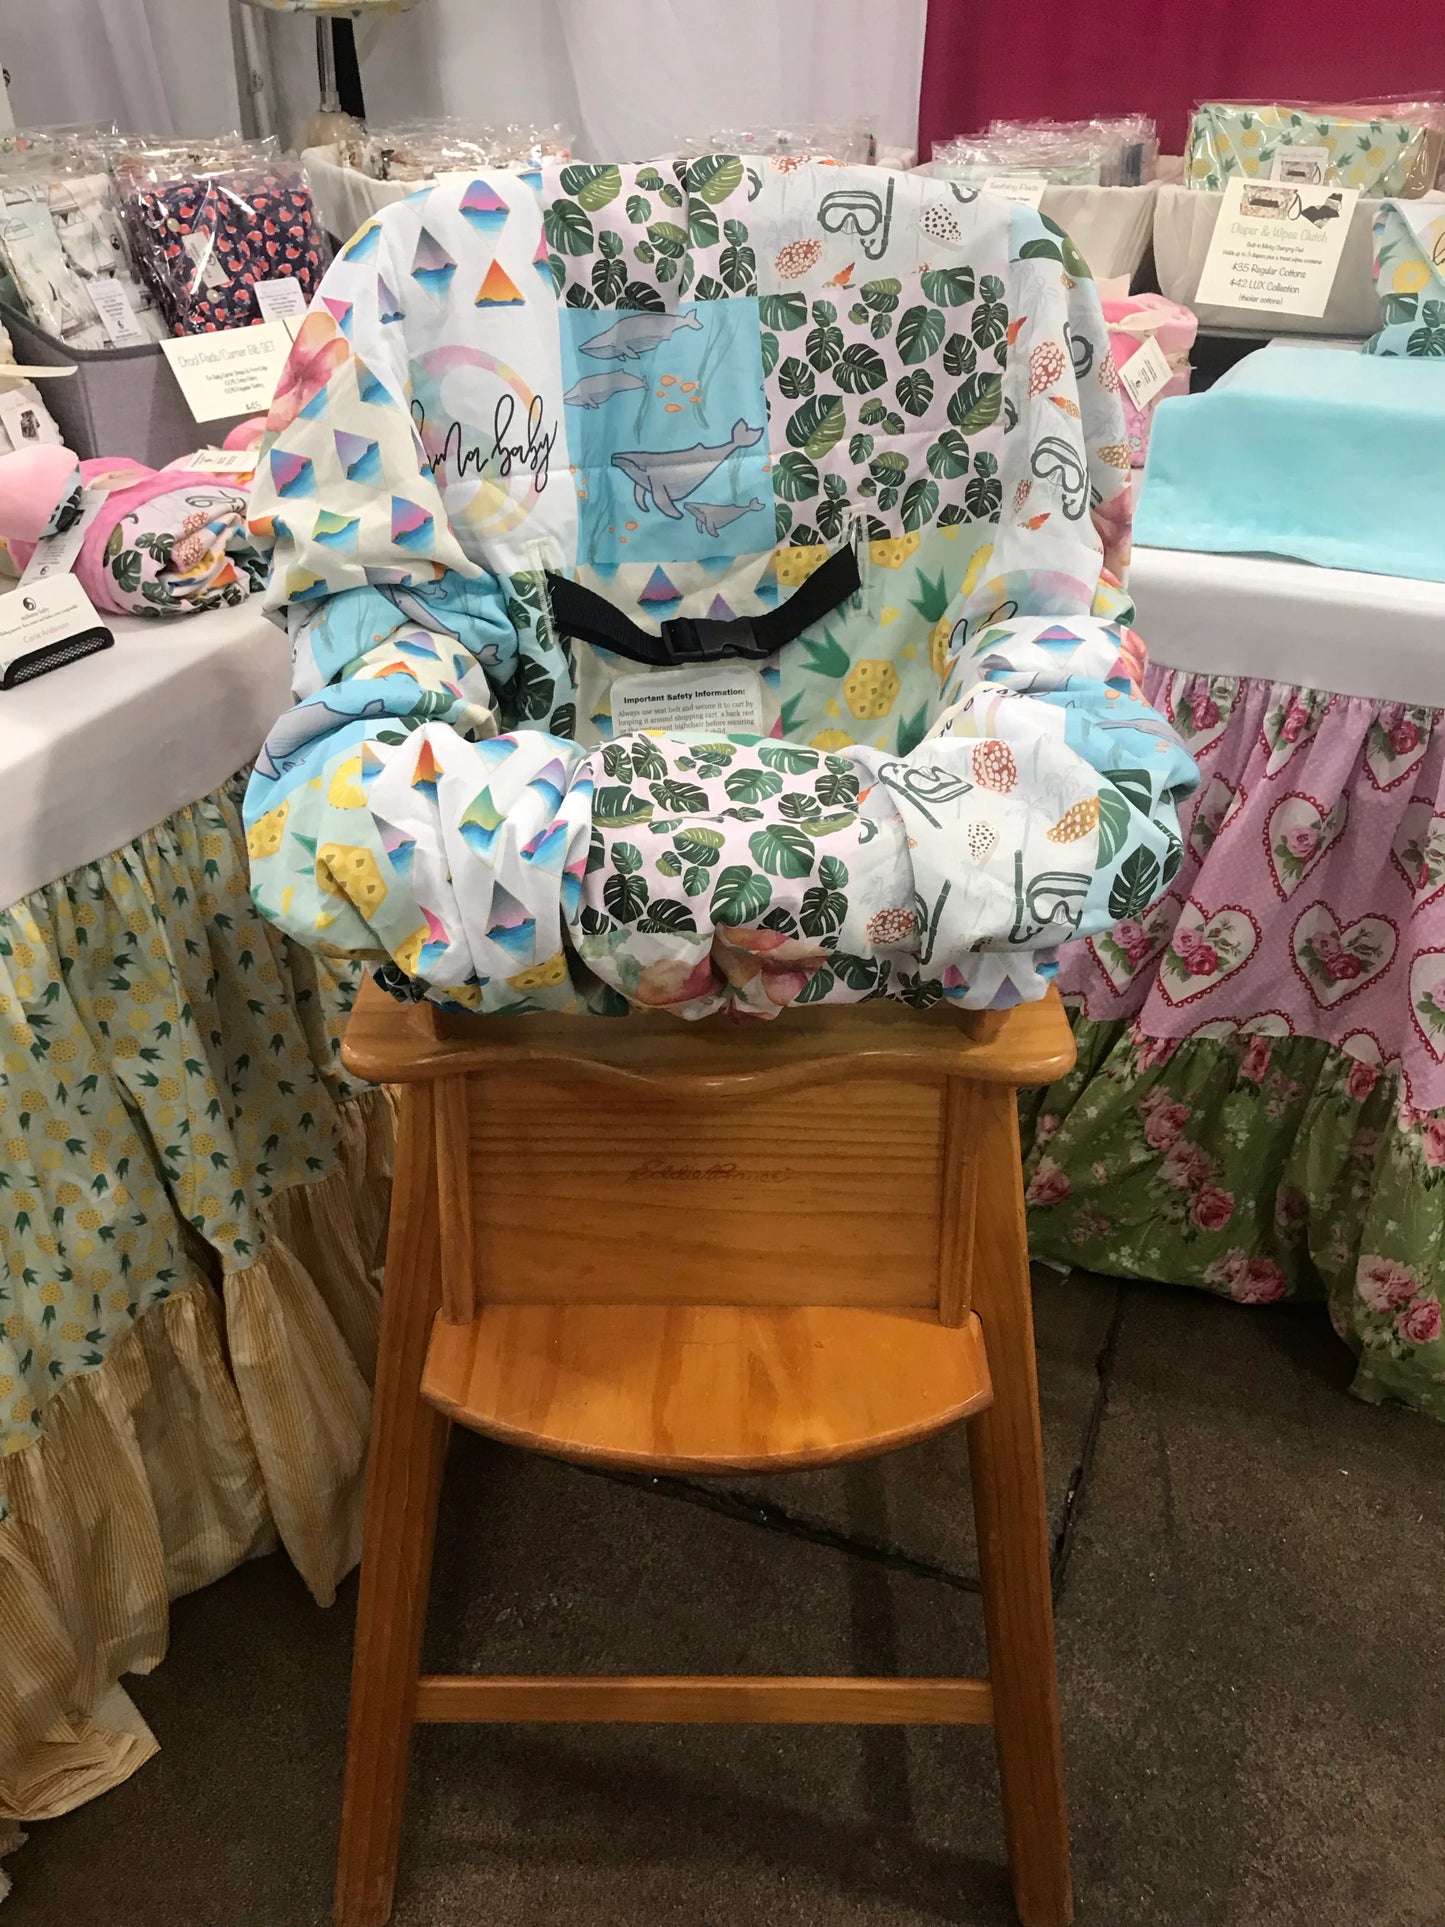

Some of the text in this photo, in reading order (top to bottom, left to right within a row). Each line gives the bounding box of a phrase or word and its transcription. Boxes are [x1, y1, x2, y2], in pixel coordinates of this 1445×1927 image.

[1231, 222, 1328, 243] Diaper & Wipes Clutch
[1232, 262, 1306, 278] $35 Regular Cottons
[1229, 278, 1300, 294] $42 LUX Collection
[491, 394, 558, 493] baby
[624, 689, 746, 704] Important Safety Information:
[668, 705, 681, 713] belt
[618, 718, 642, 726] looping
[650, 715, 673, 723] around
[674, 713, 703, 721] shopping
[674, 721, 704, 730] highchair
[706, 720, 726, 728] before
